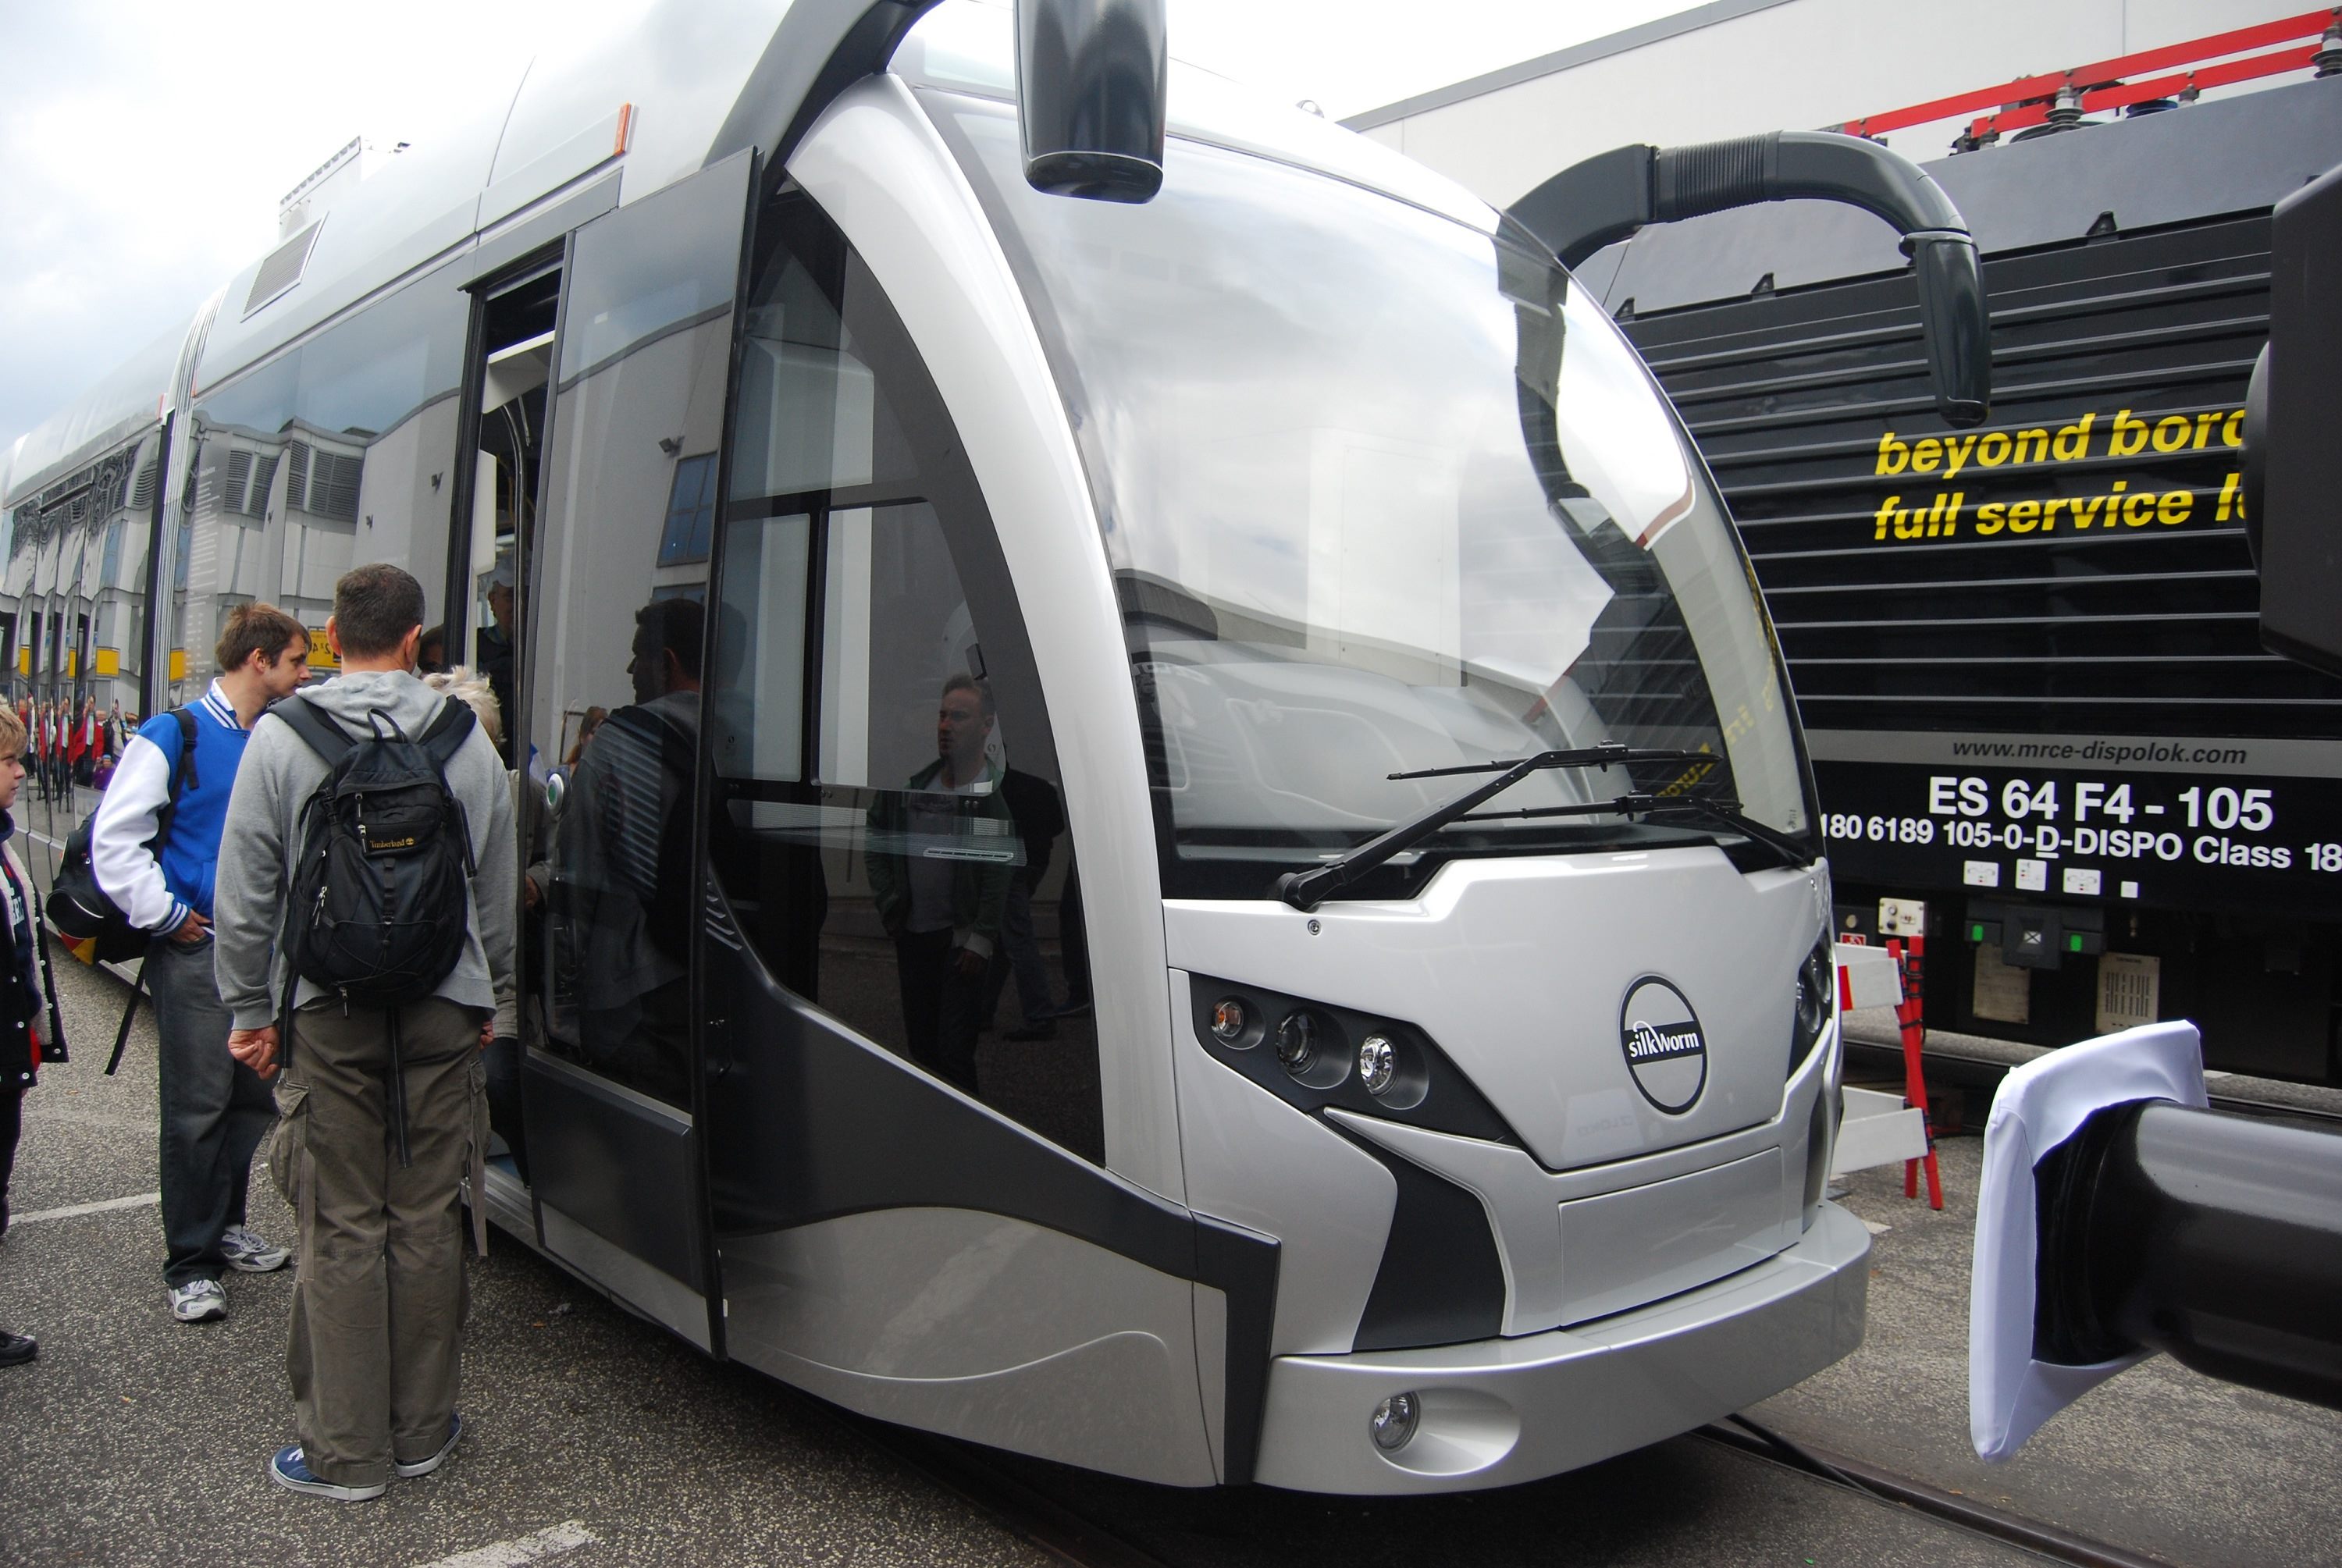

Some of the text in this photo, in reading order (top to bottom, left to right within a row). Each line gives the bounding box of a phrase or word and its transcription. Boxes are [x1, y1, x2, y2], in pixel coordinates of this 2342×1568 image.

[1874, 412, 2095, 479] beyond
[1874, 472, 2246, 540] full service l
[1953, 740, 2248, 765] www.mrce-dispolok.com
[1929, 776, 1988, 816] ES
[2002, 780, 2059, 820] 64
[2075, 783, 2134, 824] F4
[2179, 787, 2274, 831] 105
[369, 838, 404, 848] Timberland
[1867, 816, 1934, 844] 6189
[2193, 835, 2292, 869] Class
[2305, 843, 2342, 872] 18
